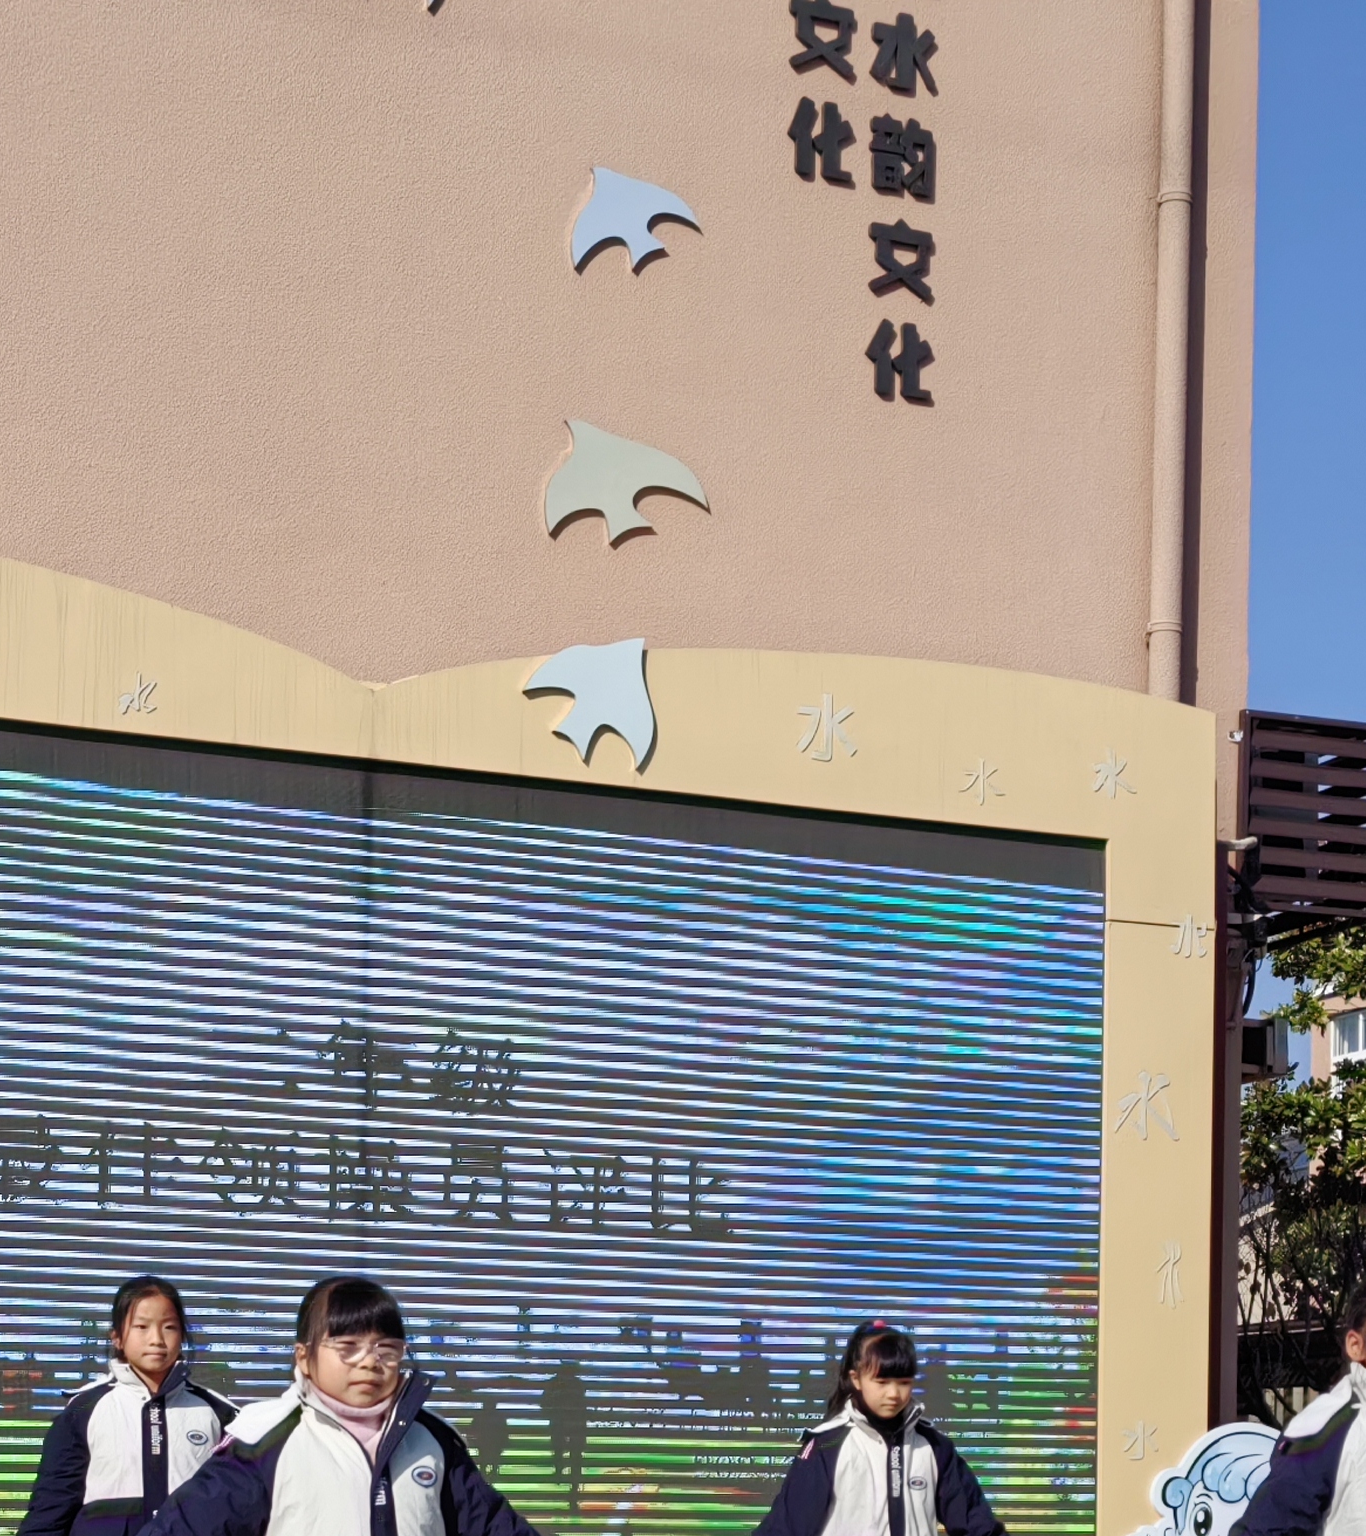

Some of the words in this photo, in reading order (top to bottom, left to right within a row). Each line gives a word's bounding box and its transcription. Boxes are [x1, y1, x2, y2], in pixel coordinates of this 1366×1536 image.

[865, 12, 939, 407] 水韵文化
[795, 692, 858, 762] 水
